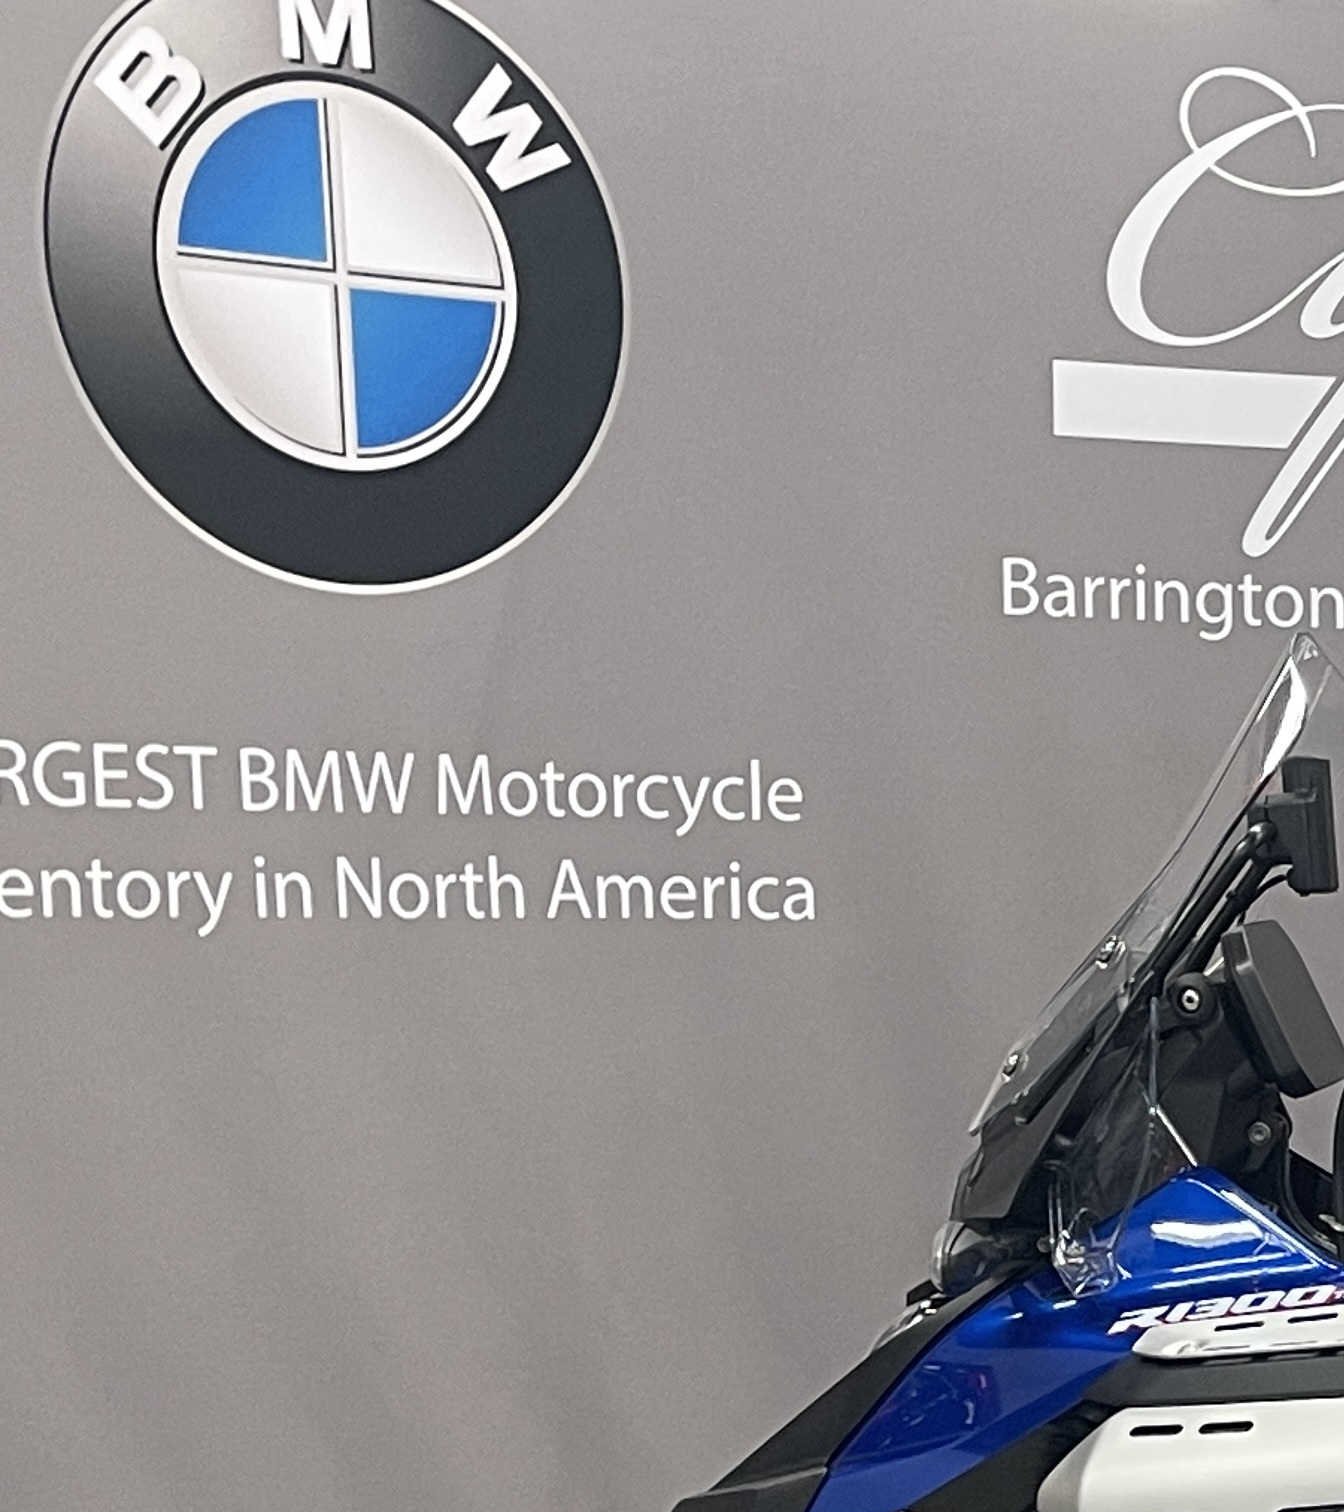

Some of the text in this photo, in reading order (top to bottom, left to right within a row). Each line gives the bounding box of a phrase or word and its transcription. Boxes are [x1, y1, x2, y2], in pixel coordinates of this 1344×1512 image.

[94, 0, 572, 192] BMW
[0, 739, 804, 837] RGEST BMW Motorcycle
[0, 855, 816, 938] entory in North America
[1106, 1284, 1337, 1335] R1300
